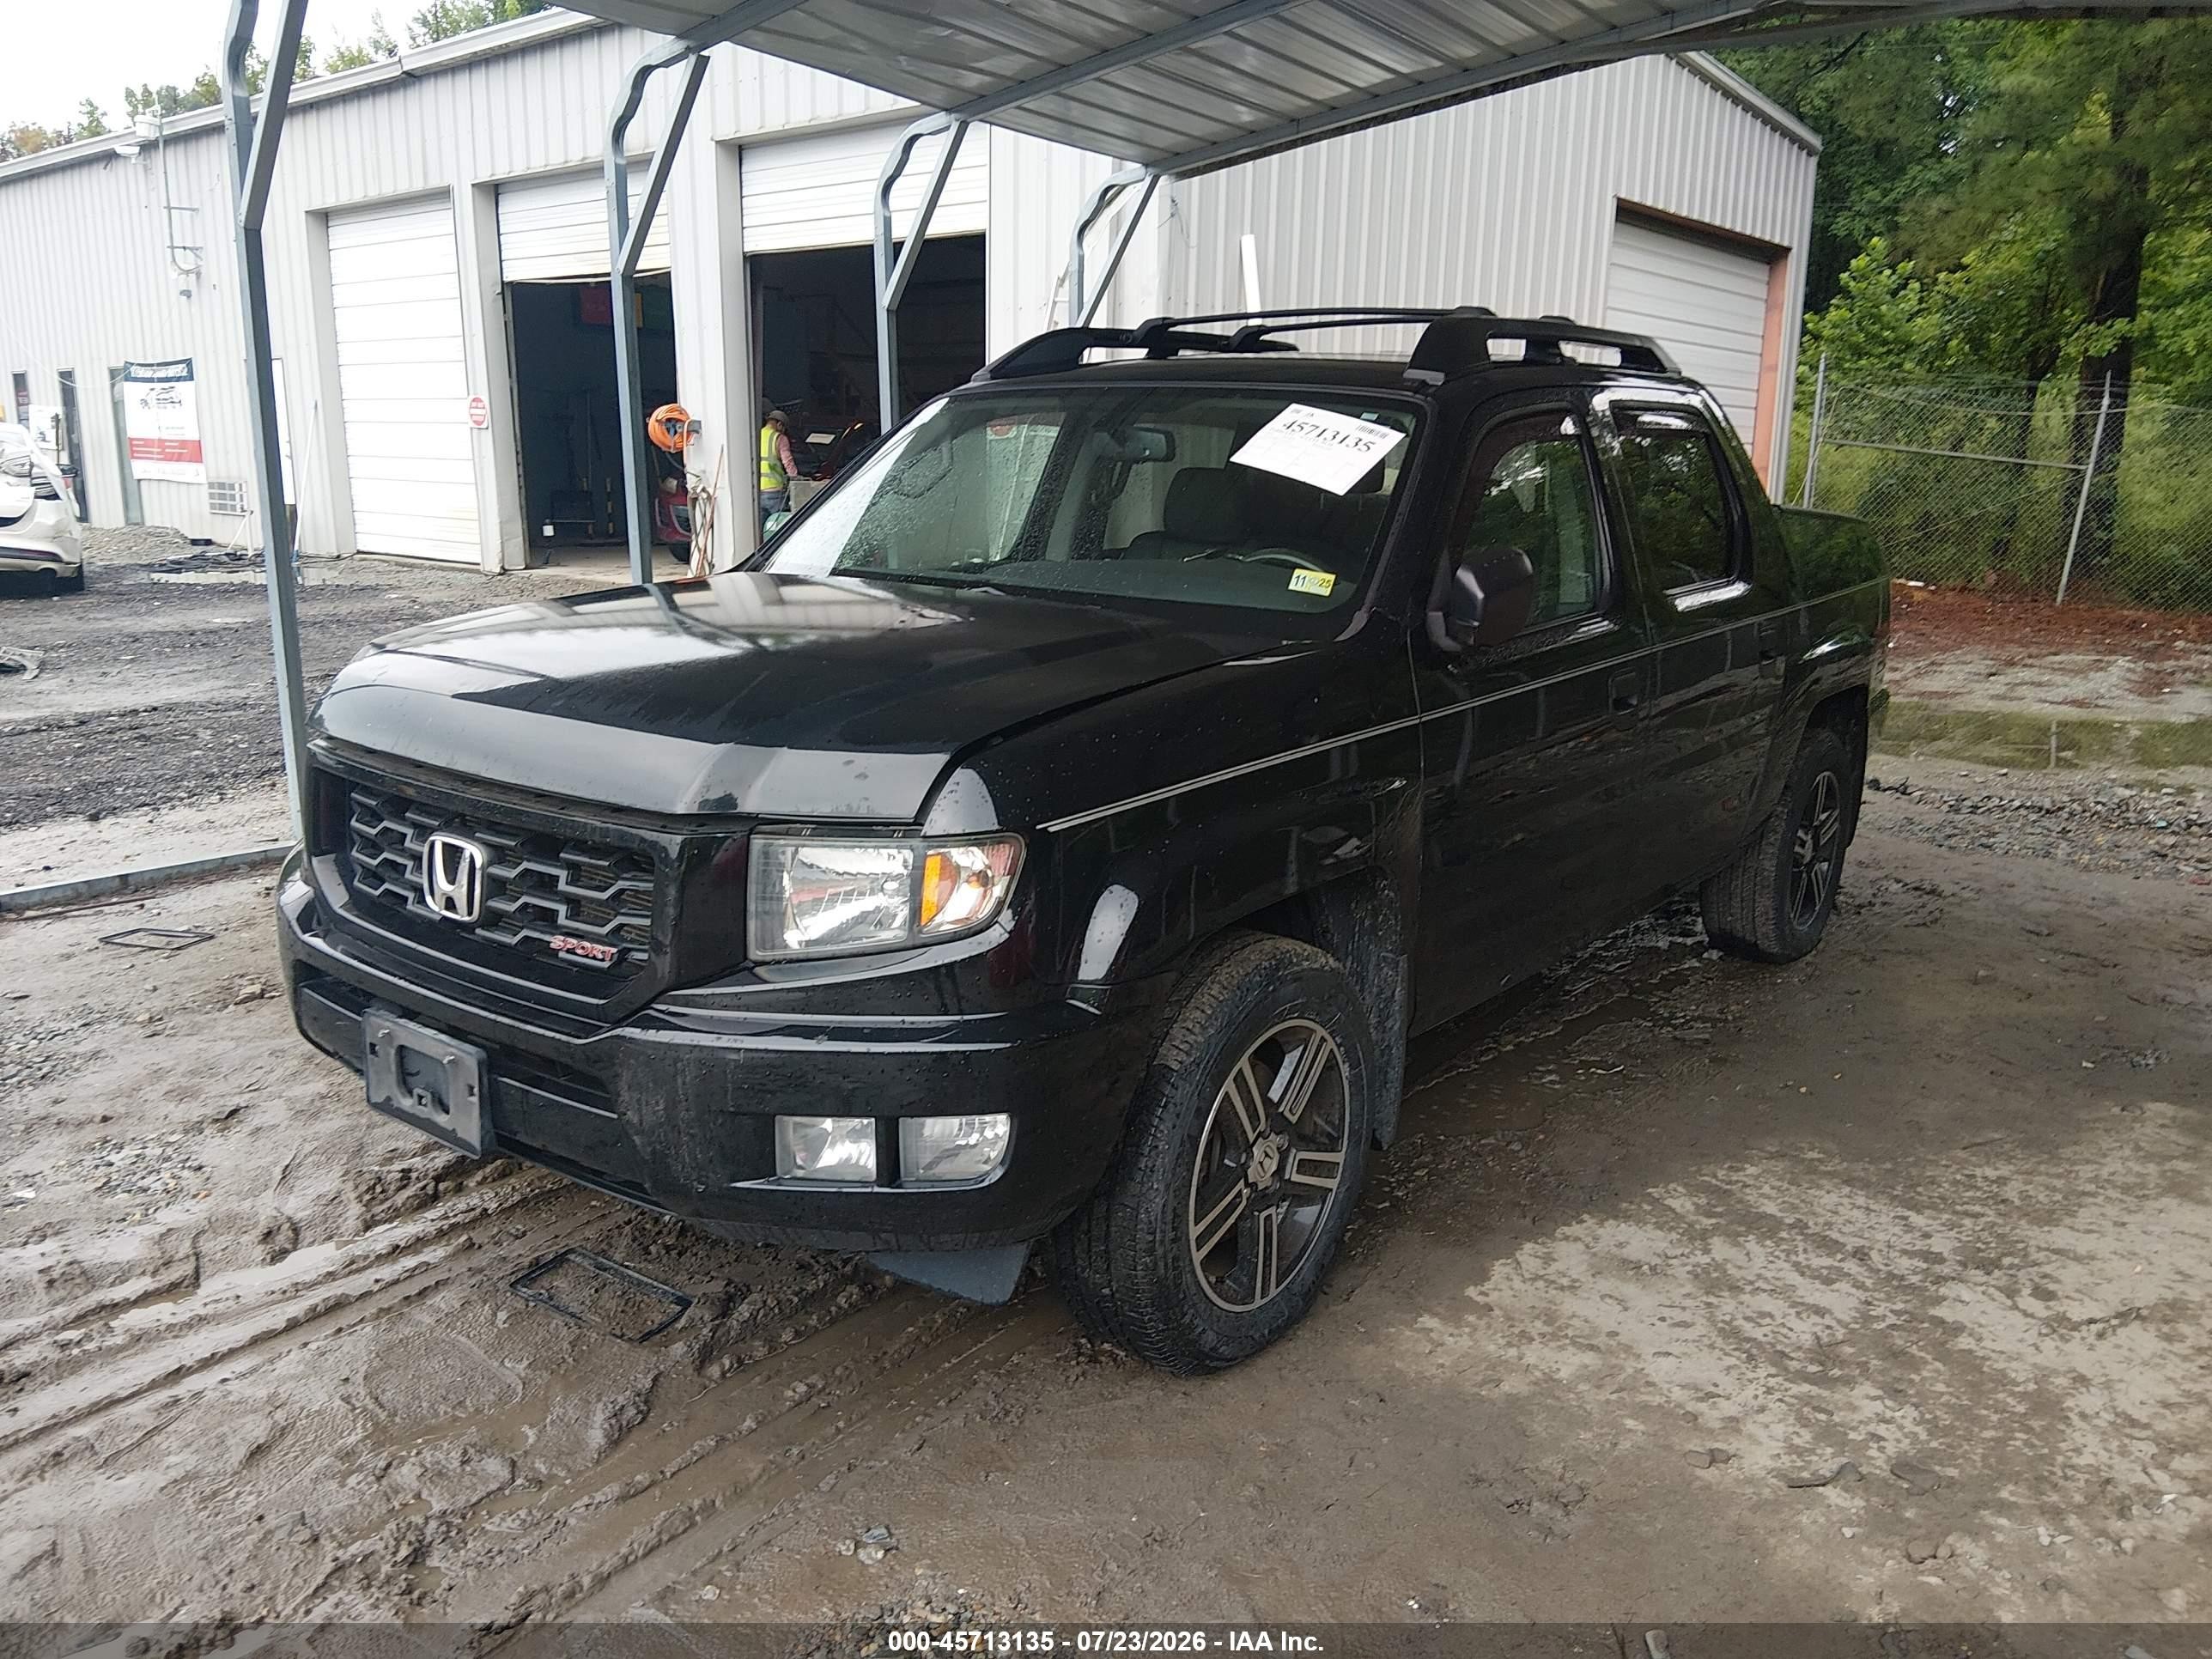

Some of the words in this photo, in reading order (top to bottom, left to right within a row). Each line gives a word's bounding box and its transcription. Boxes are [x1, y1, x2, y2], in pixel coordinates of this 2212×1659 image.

[1283, 419, 1376, 453] 45713135
[1293, 574, 1307, 587] 11
[549, 934, 619, 962] SPORT
